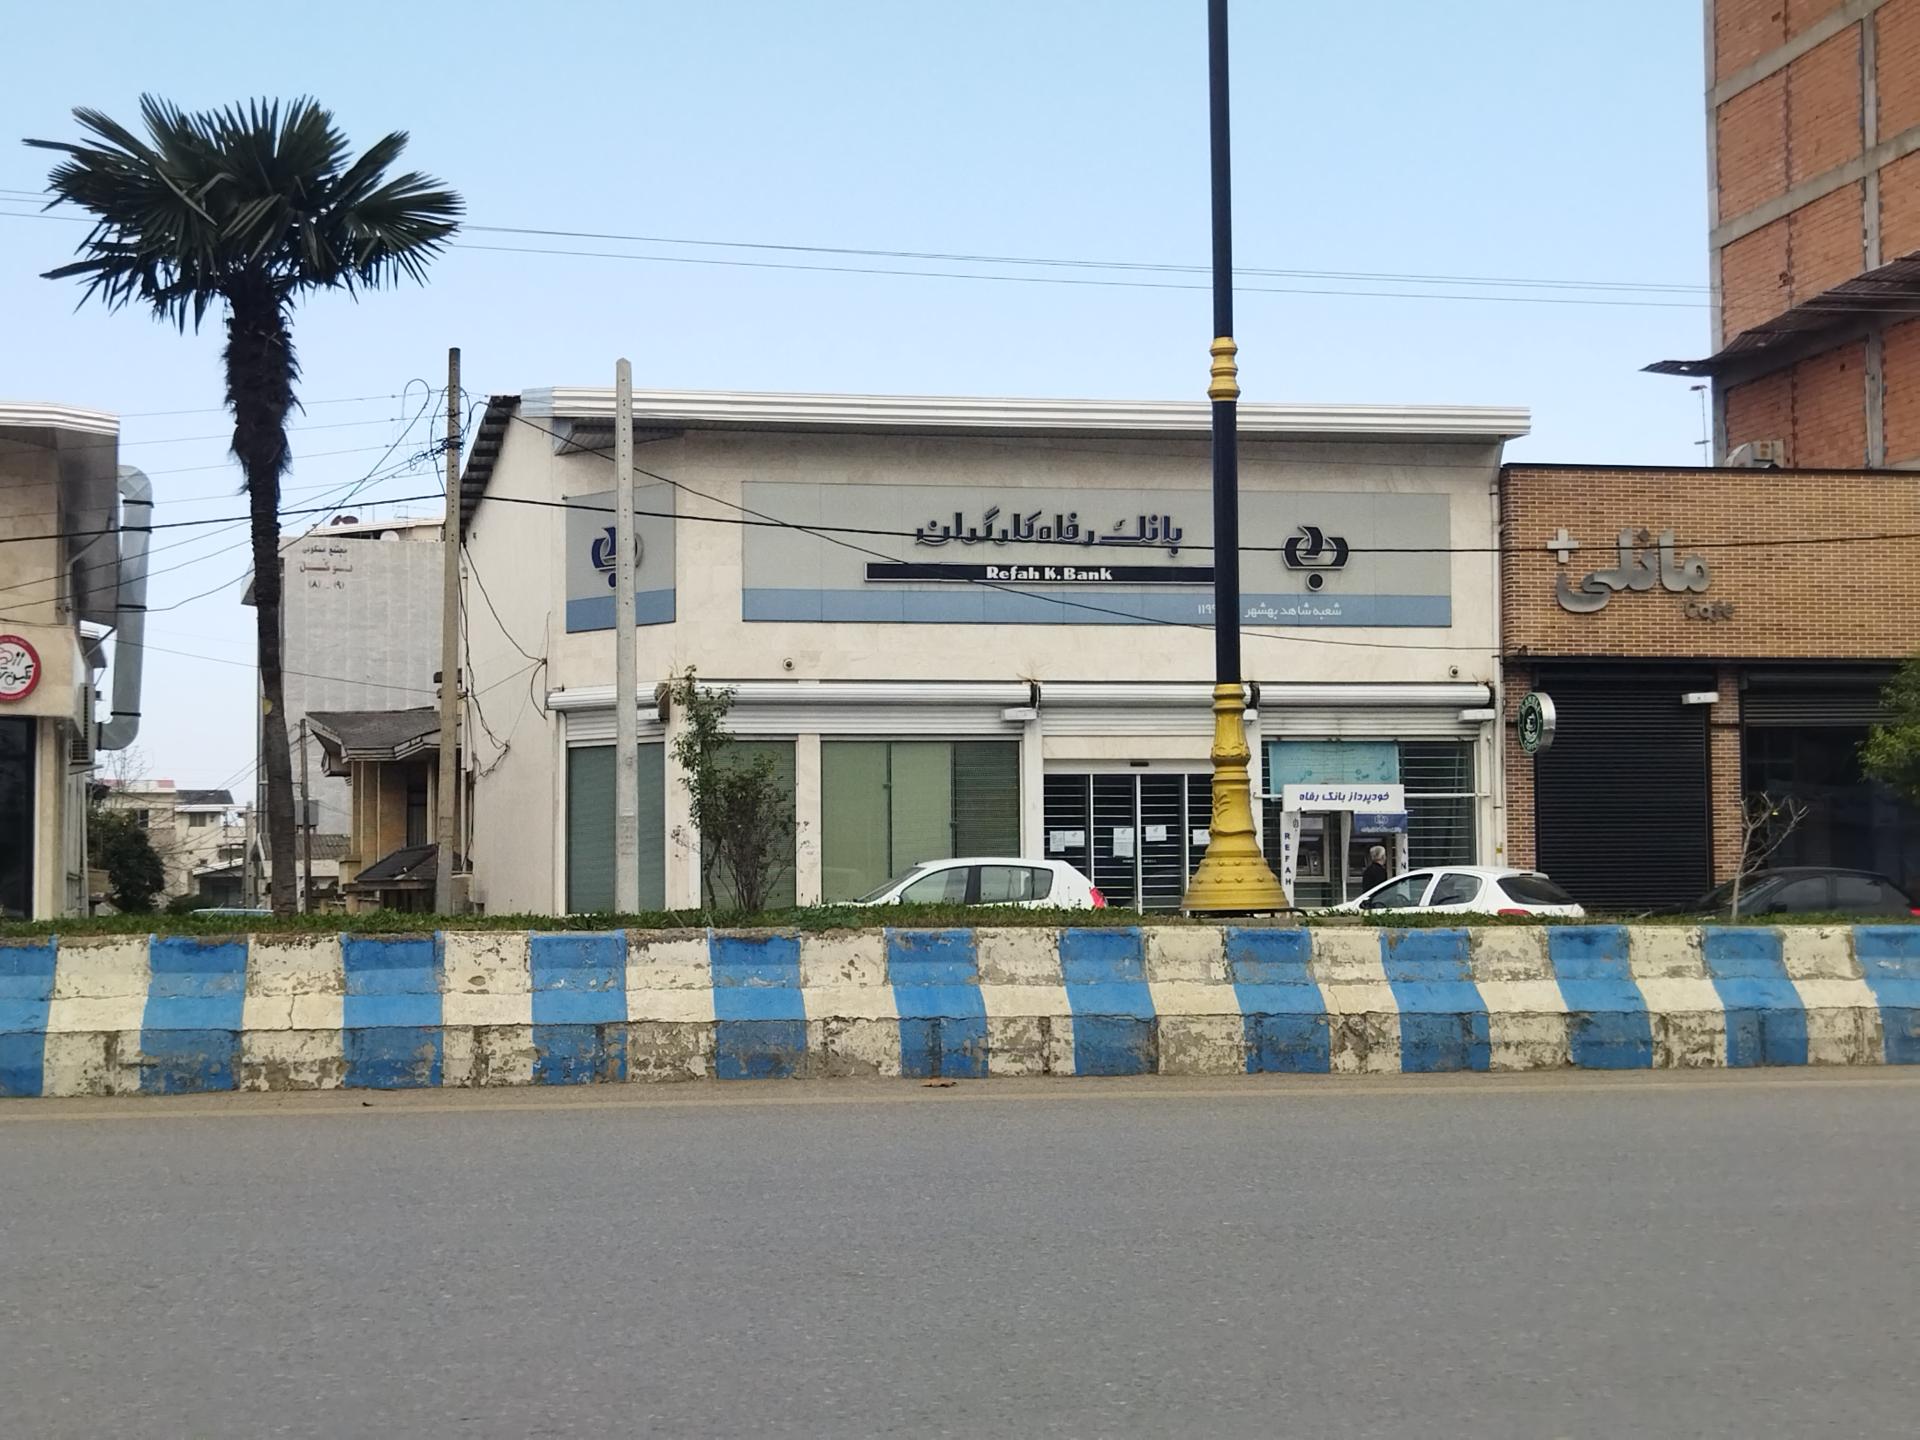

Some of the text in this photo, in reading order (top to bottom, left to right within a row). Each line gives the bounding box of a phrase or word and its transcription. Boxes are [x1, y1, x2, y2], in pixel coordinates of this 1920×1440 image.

[986, 566, 1040, 580] Refah
[1244, 602, 1279, 620] بهشهر
[1279, 602, 1312, 616] شاهد
[1313, 602, 1342, 620] شعبه
[1299, 791, 1390, 804] خودپرداز بانک رفاه
[1284, 832, 1292, 885] REFAH
